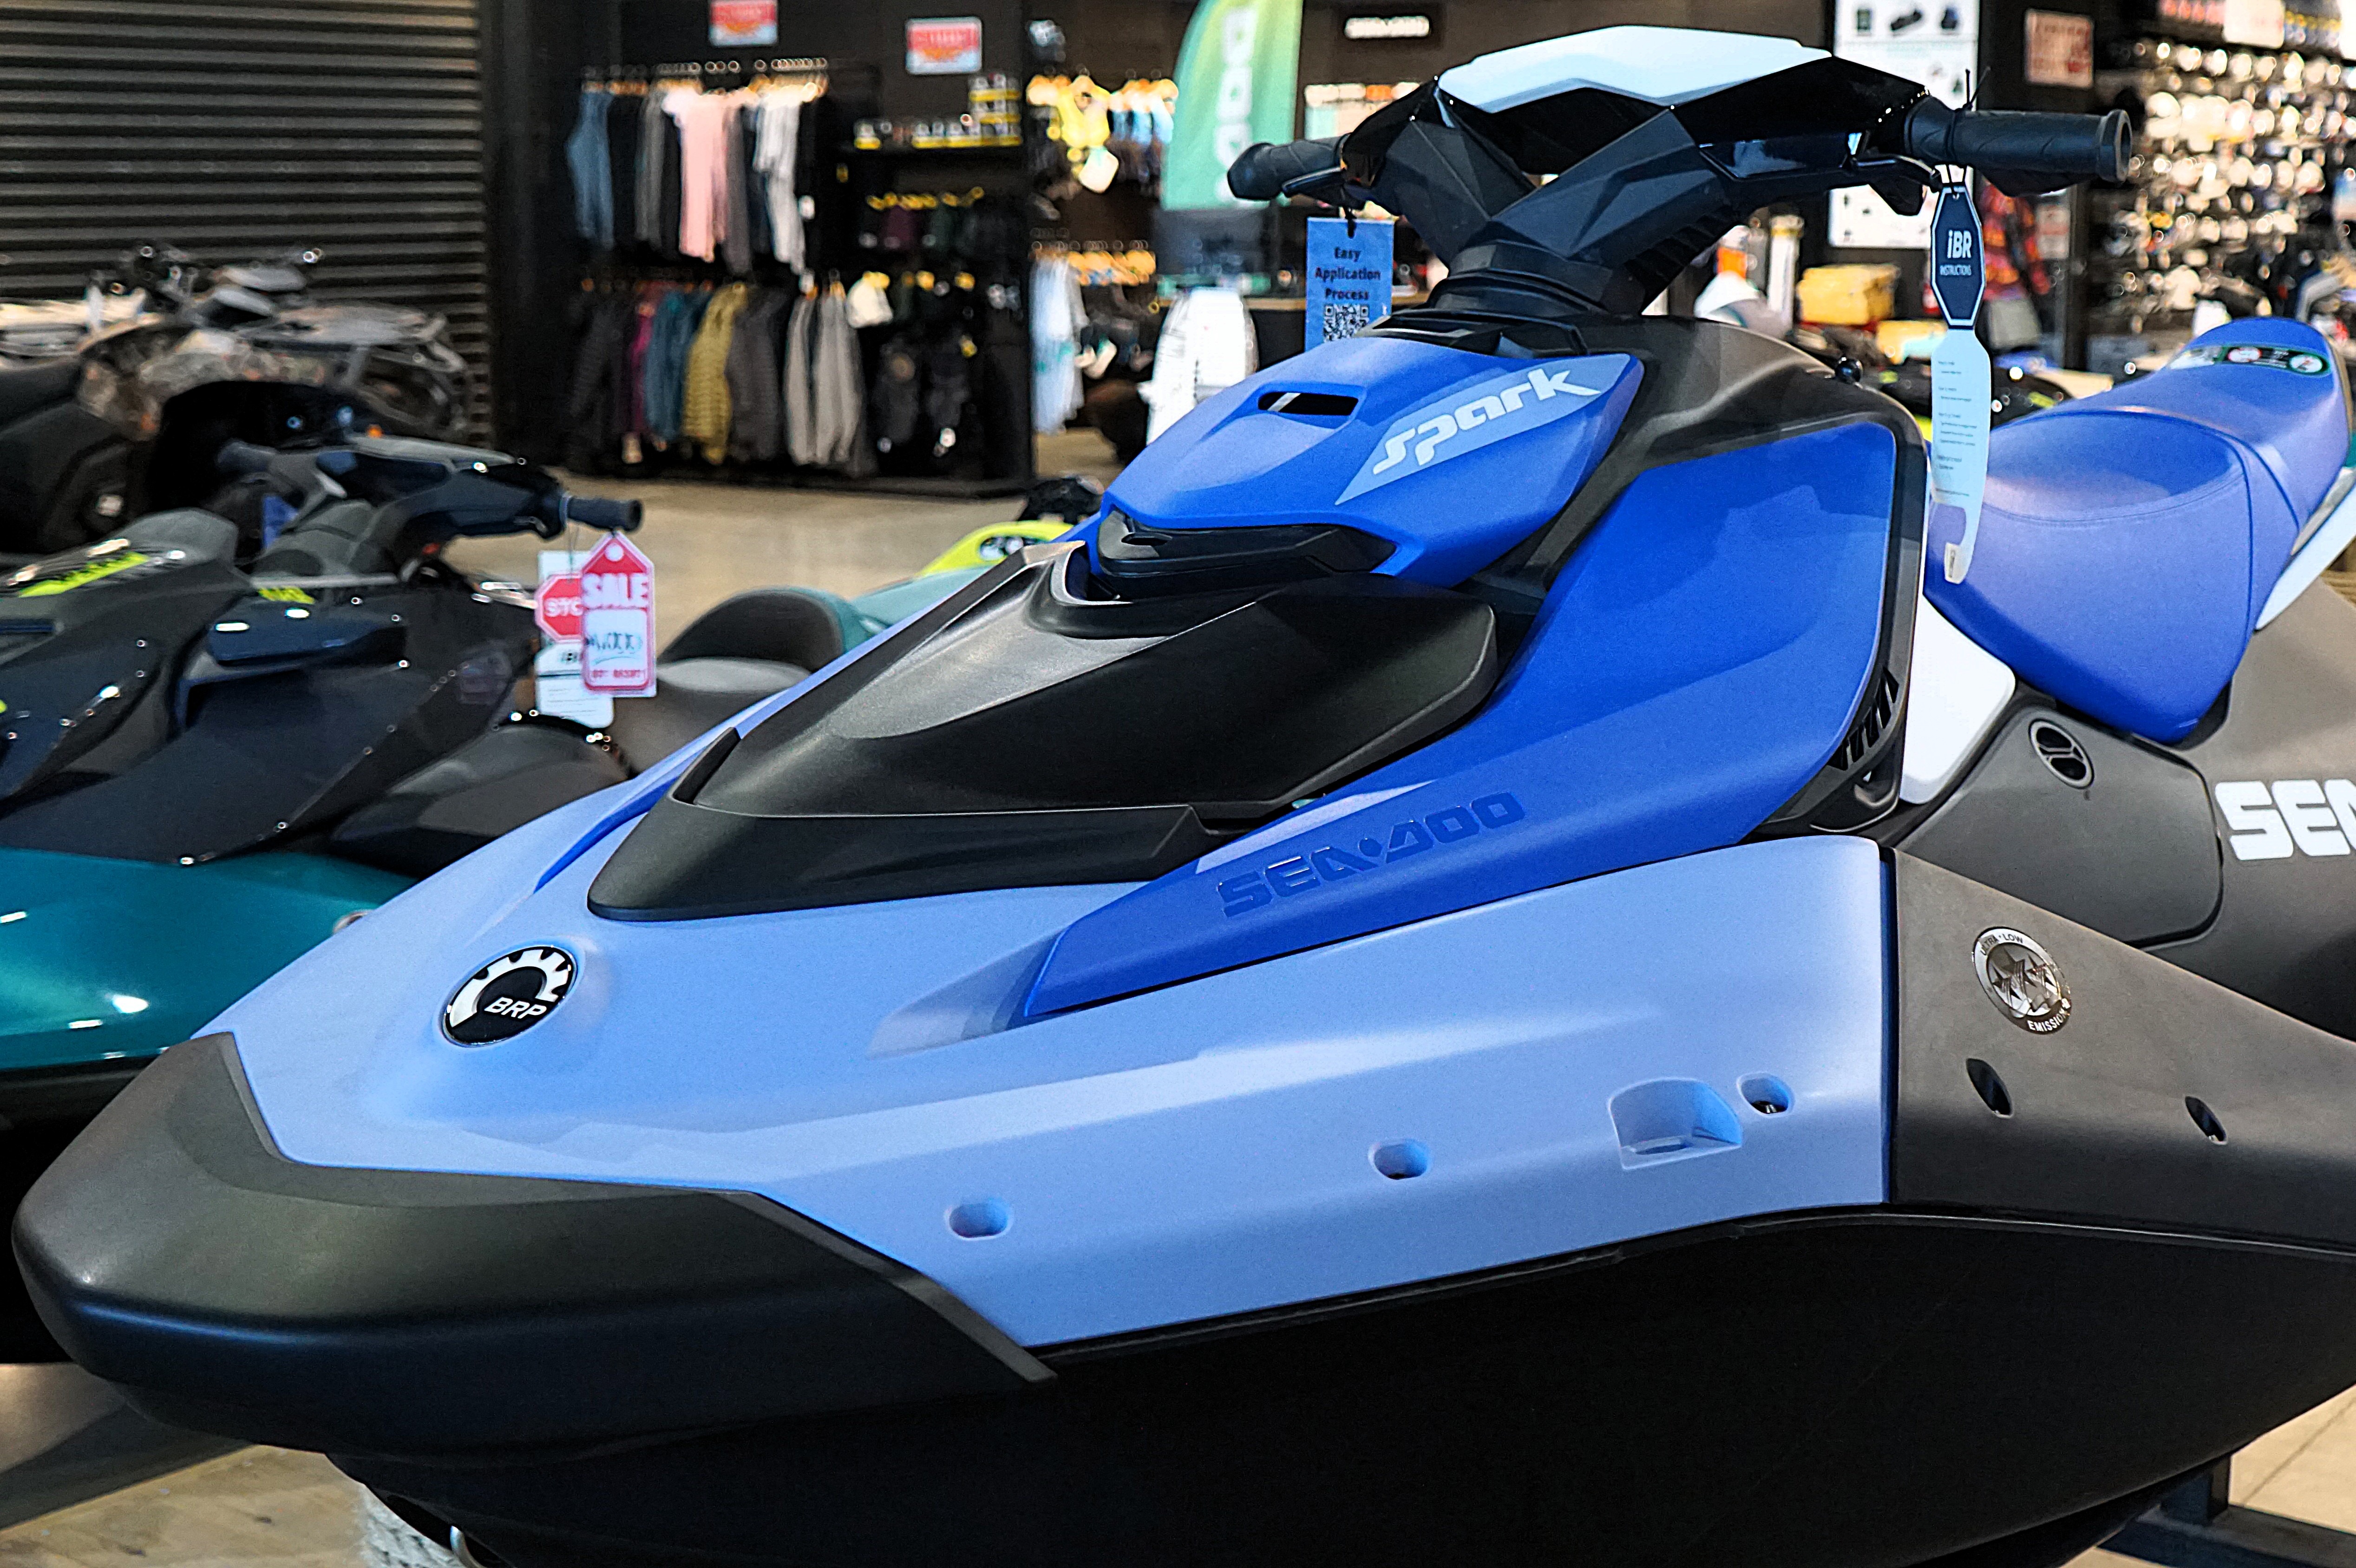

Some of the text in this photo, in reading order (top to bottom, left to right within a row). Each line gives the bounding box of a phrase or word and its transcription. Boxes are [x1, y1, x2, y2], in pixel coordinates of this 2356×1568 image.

[1334, 246, 1361, 262] Easy
[1947, 229, 1972, 259] iBR
[1315, 266, 1381, 283] Application
[1325, 287, 1369, 301] Process
[582, 572, 649, 608] SALE
[544, 597, 583, 617] STO
[484, 997, 547, 1019] BRP
